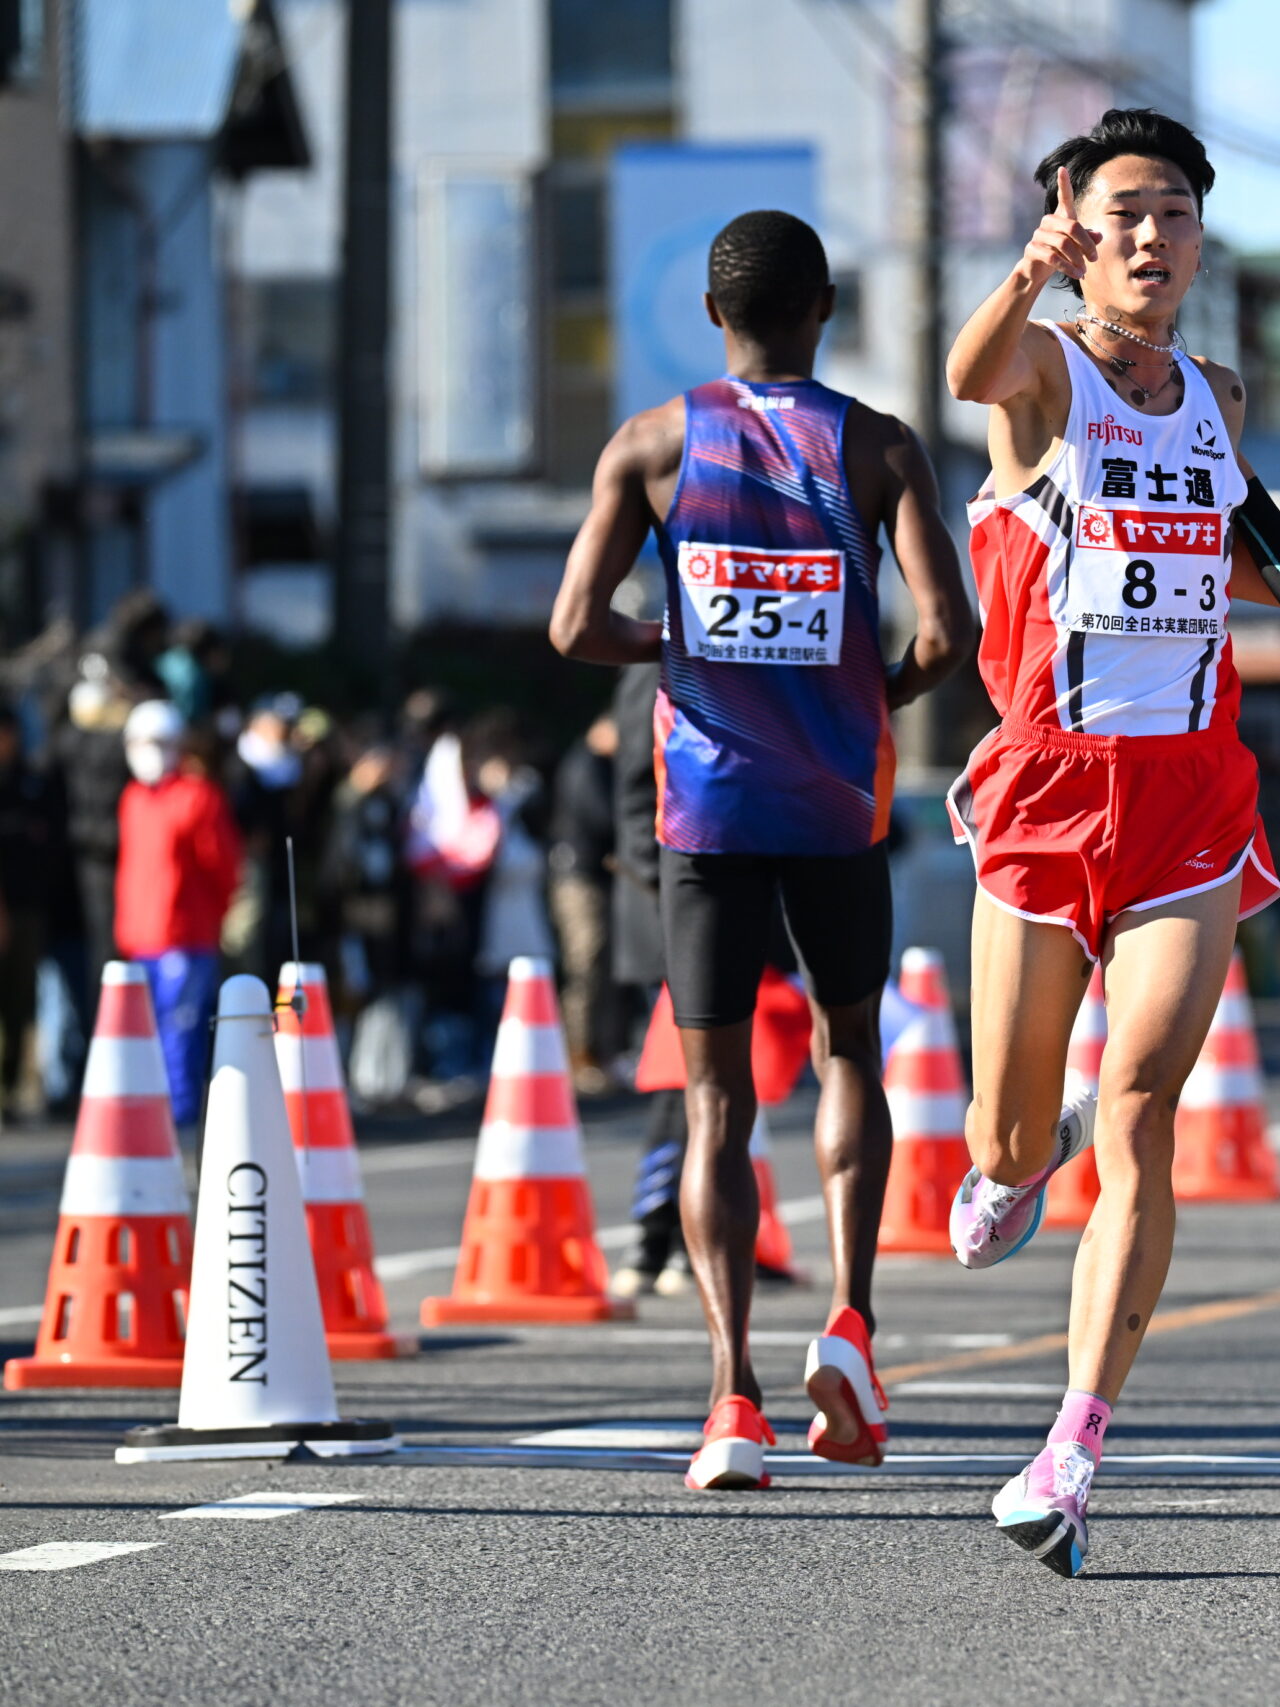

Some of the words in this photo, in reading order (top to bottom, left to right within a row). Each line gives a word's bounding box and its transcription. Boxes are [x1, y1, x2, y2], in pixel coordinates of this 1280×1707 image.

[1087, 414, 1143, 446] FUJITSU
[1101, 457, 1215, 508] 富士通
[1121, 519, 1216, 546] ヤマザキ
[721, 558, 833, 585] ヤマザキ
[706, 594, 829, 642] 25-4
[1081, 612, 1218, 635] 第70回全日本実業団駅伝
[226, 1161, 268, 1387] CITIZEN
